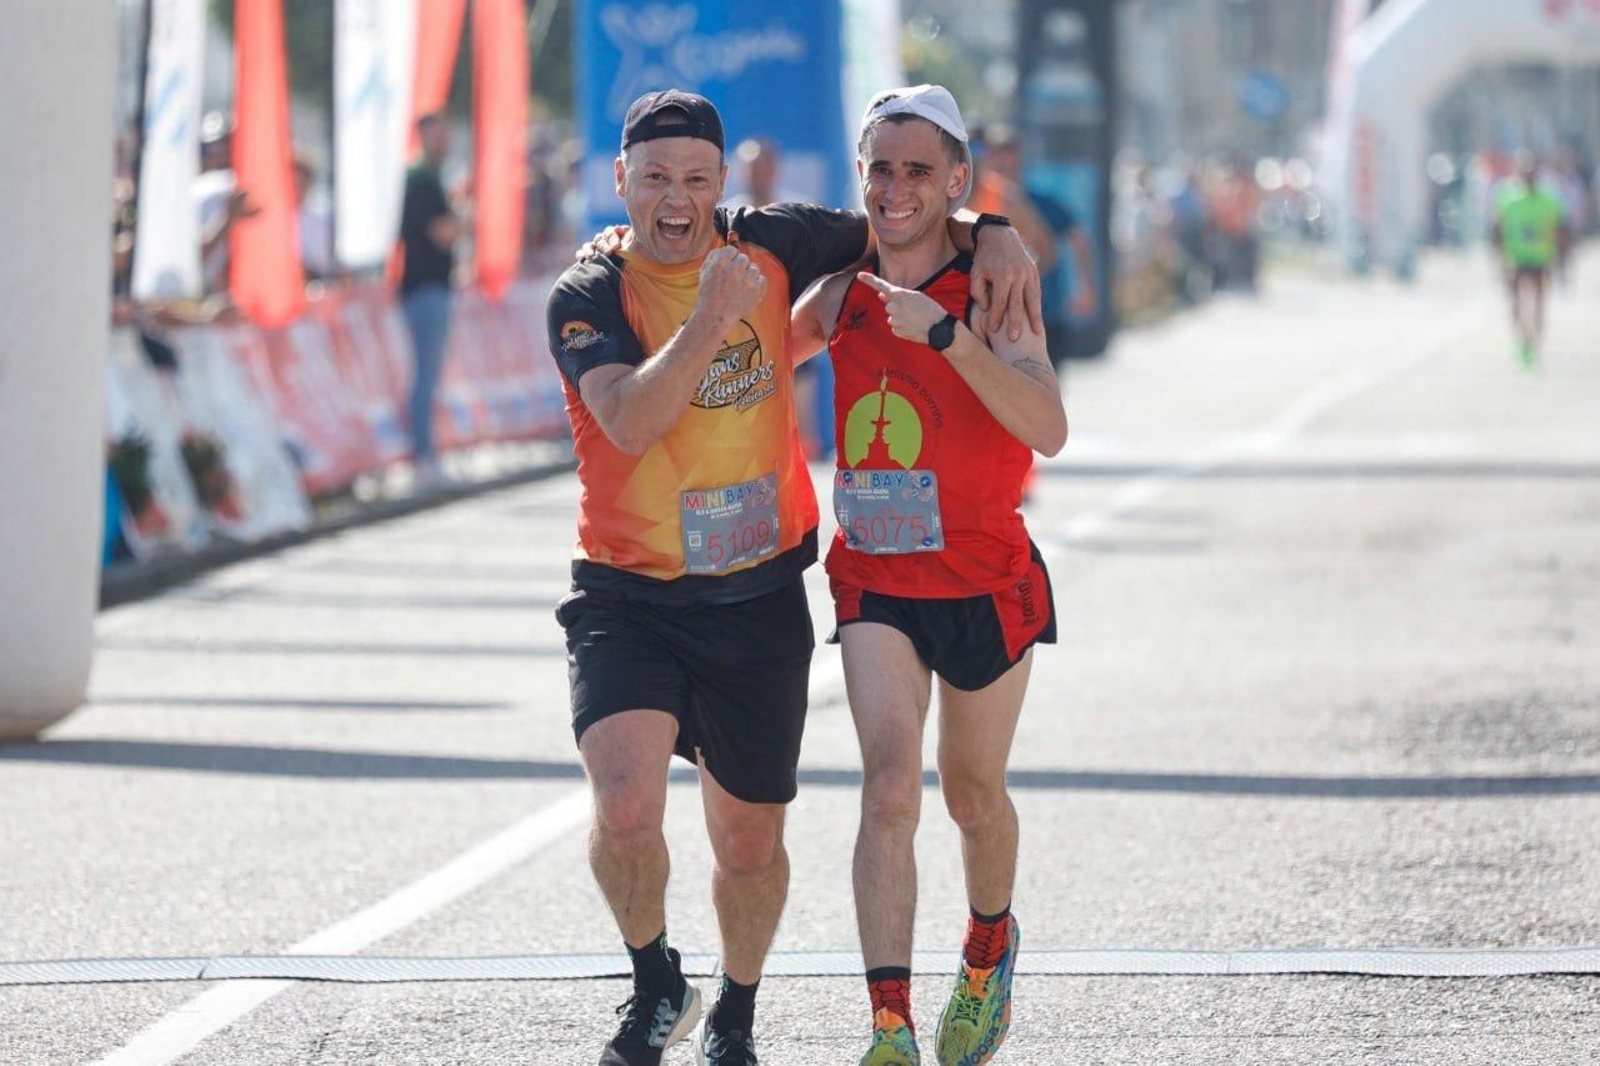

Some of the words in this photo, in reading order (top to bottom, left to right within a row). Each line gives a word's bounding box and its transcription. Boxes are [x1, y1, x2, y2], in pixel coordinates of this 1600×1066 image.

[704, 361, 775, 408] Runners
[707, 520, 771, 564] 5109
[853, 513, 928, 544] 5075
